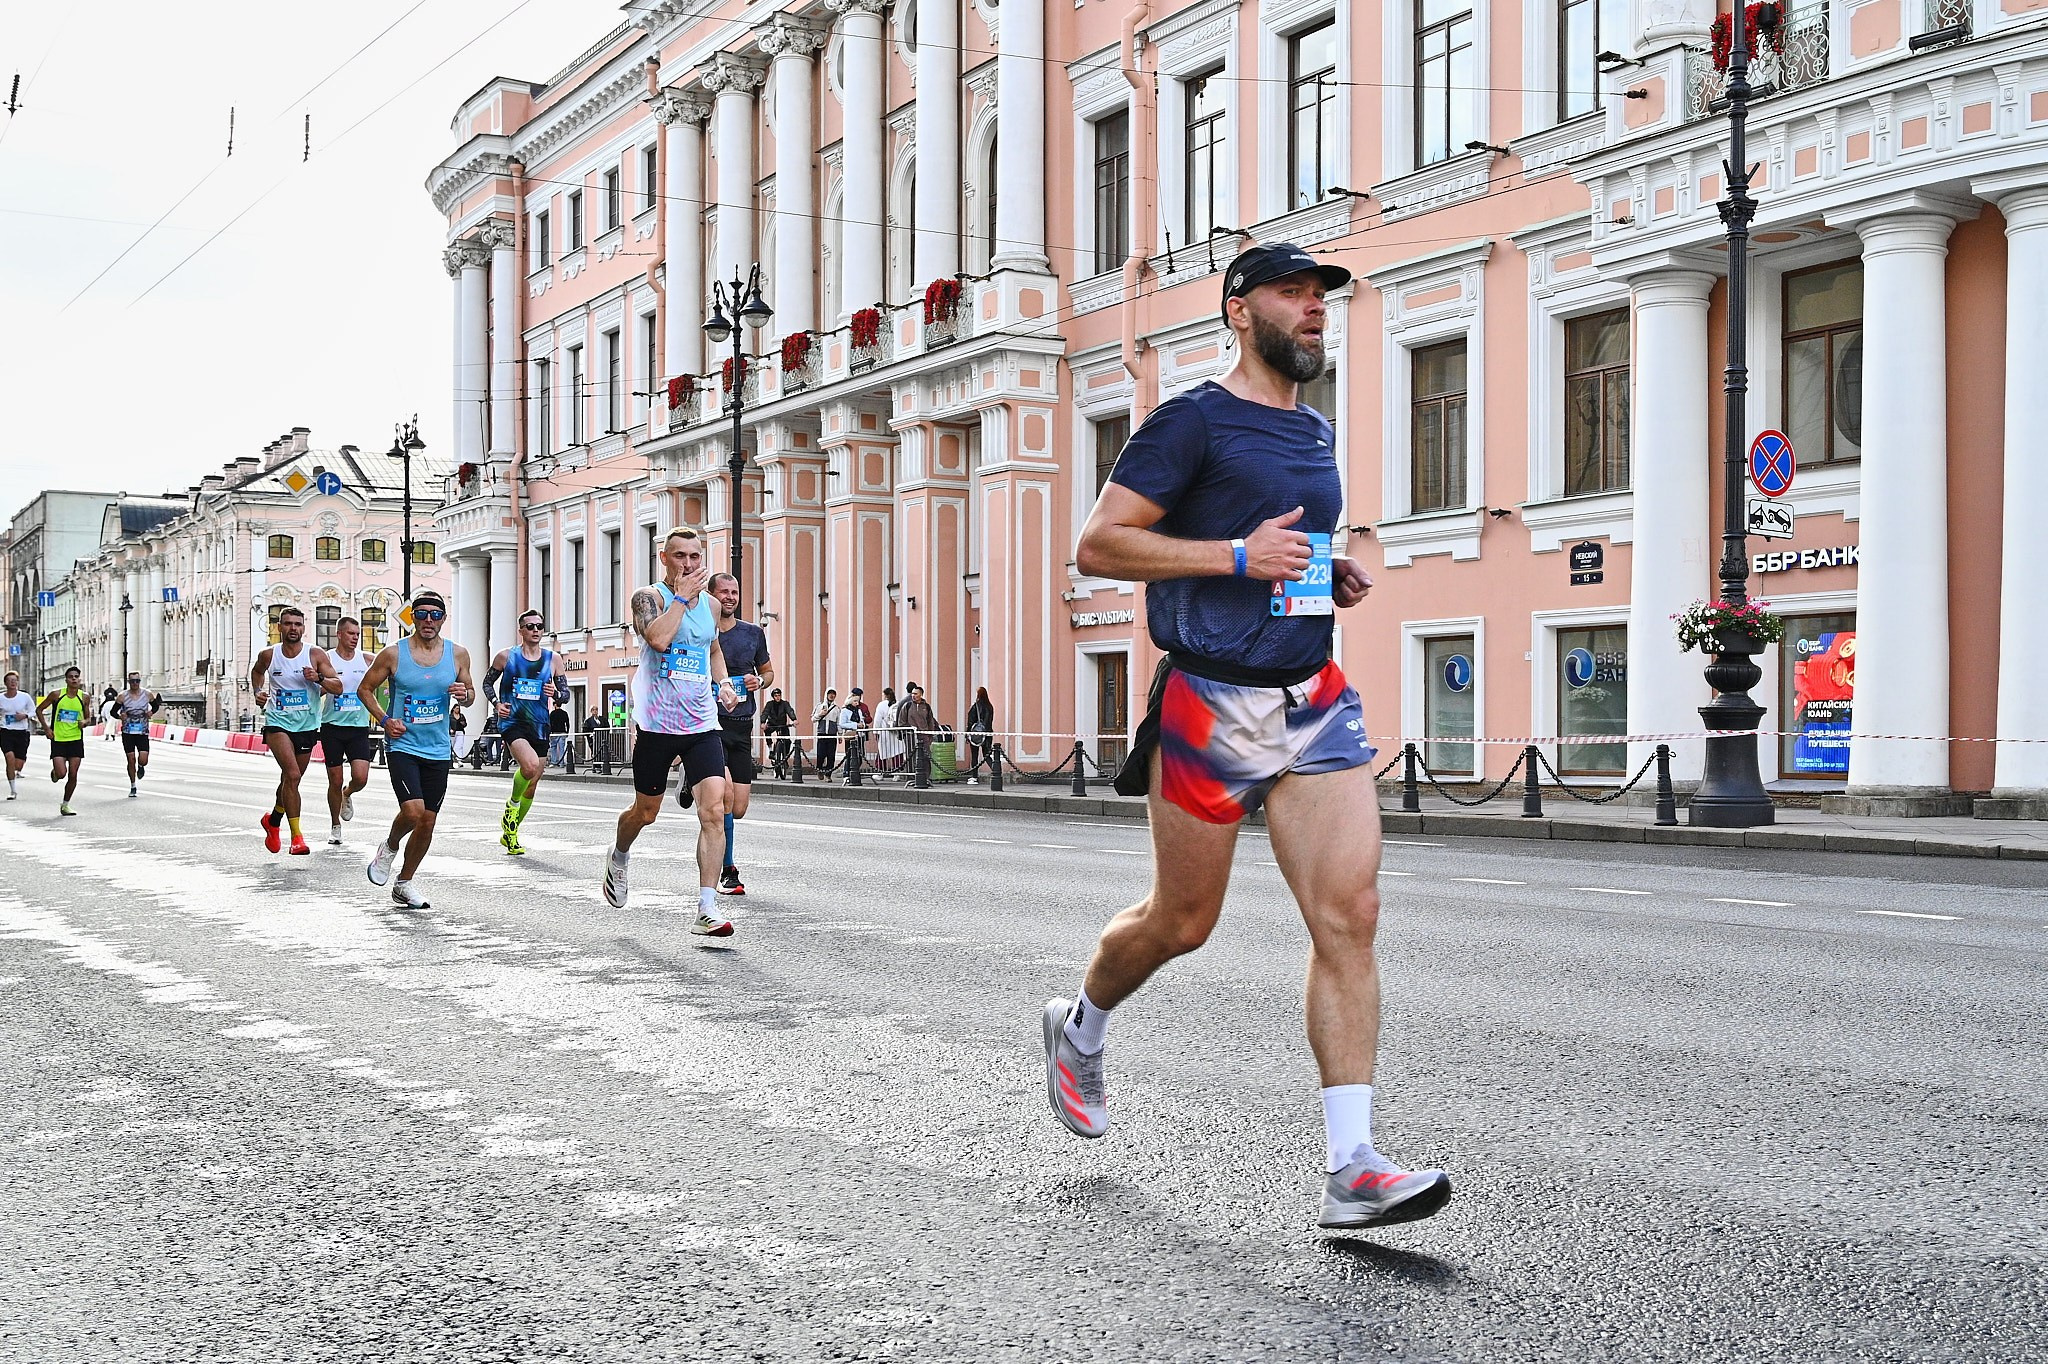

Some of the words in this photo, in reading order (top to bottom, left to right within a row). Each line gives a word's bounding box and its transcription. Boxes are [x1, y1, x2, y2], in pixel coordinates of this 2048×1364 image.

[1575, 550, 1598, 560] НЕВСКИЙ
[1752, 551, 1798, 573] ББР
[1800, 545, 1860, 569] БАНК
[675, 657, 700, 670] 4822
[1596, 651, 1627, 666] ББР
[285, 696, 303, 704] 9410
[415, 705, 439, 714] 4036
[1807, 709, 1832, 718] ЮАНЬ
